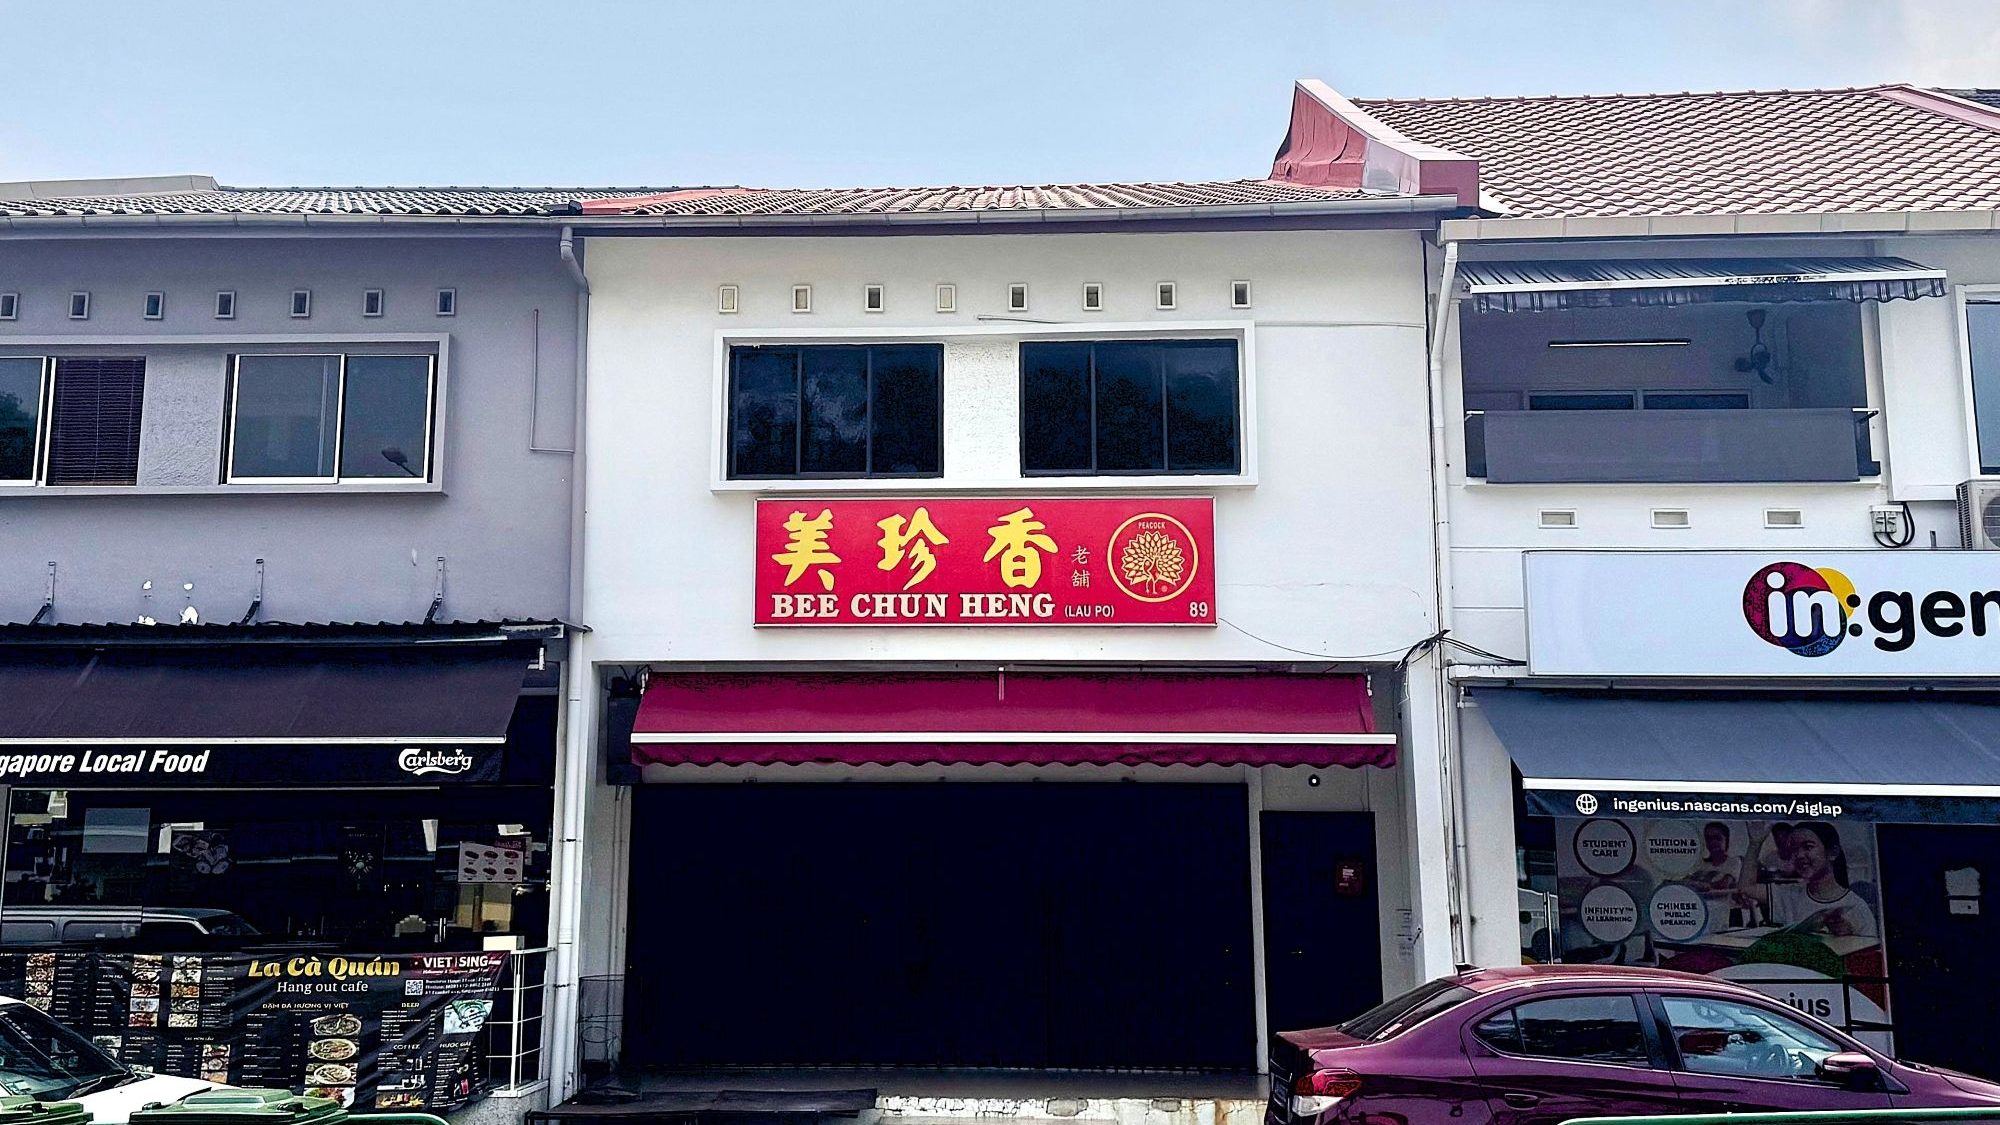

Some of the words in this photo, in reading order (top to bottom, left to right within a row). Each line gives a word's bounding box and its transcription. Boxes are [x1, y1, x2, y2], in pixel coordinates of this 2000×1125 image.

[1138, 521, 1166, 529] PEACOCK
[771, 506, 1058, 591] 美珍香
[771, 593, 840, 618] BEE
[850, 593, 949, 618] CHUN
[959, 593, 1056, 618] HENG
[1064, 605, 1091, 618] (LAU
[1094, 605, 1115, 618] PO)
[1189, 601, 1209, 618] 89
[79, 750, 147, 773] Local
[149, 750, 211, 773] Food
[398, 748, 473, 776] Carlsberg
[1613, 797, 1843, 817] ingenius.nascans.com/siglap
[1582, 839, 1627, 848] STUDENT
[1648, 838, 1688, 847] TUITION
[1689, 838, 1697, 847] &
[1592, 849, 1619, 857] CARE
[1656, 902, 1698, 911] CHINESE
[248, 960, 281, 977] La
[287, 956, 322, 977] Cà
[328, 956, 400, 981] Quán
[423, 957, 453, 968] VIET
[459, 956, 489, 967] SING
[276, 982, 312, 995] Hang
[315, 983, 338, 993] out
[341, 981, 369, 993] cafe
